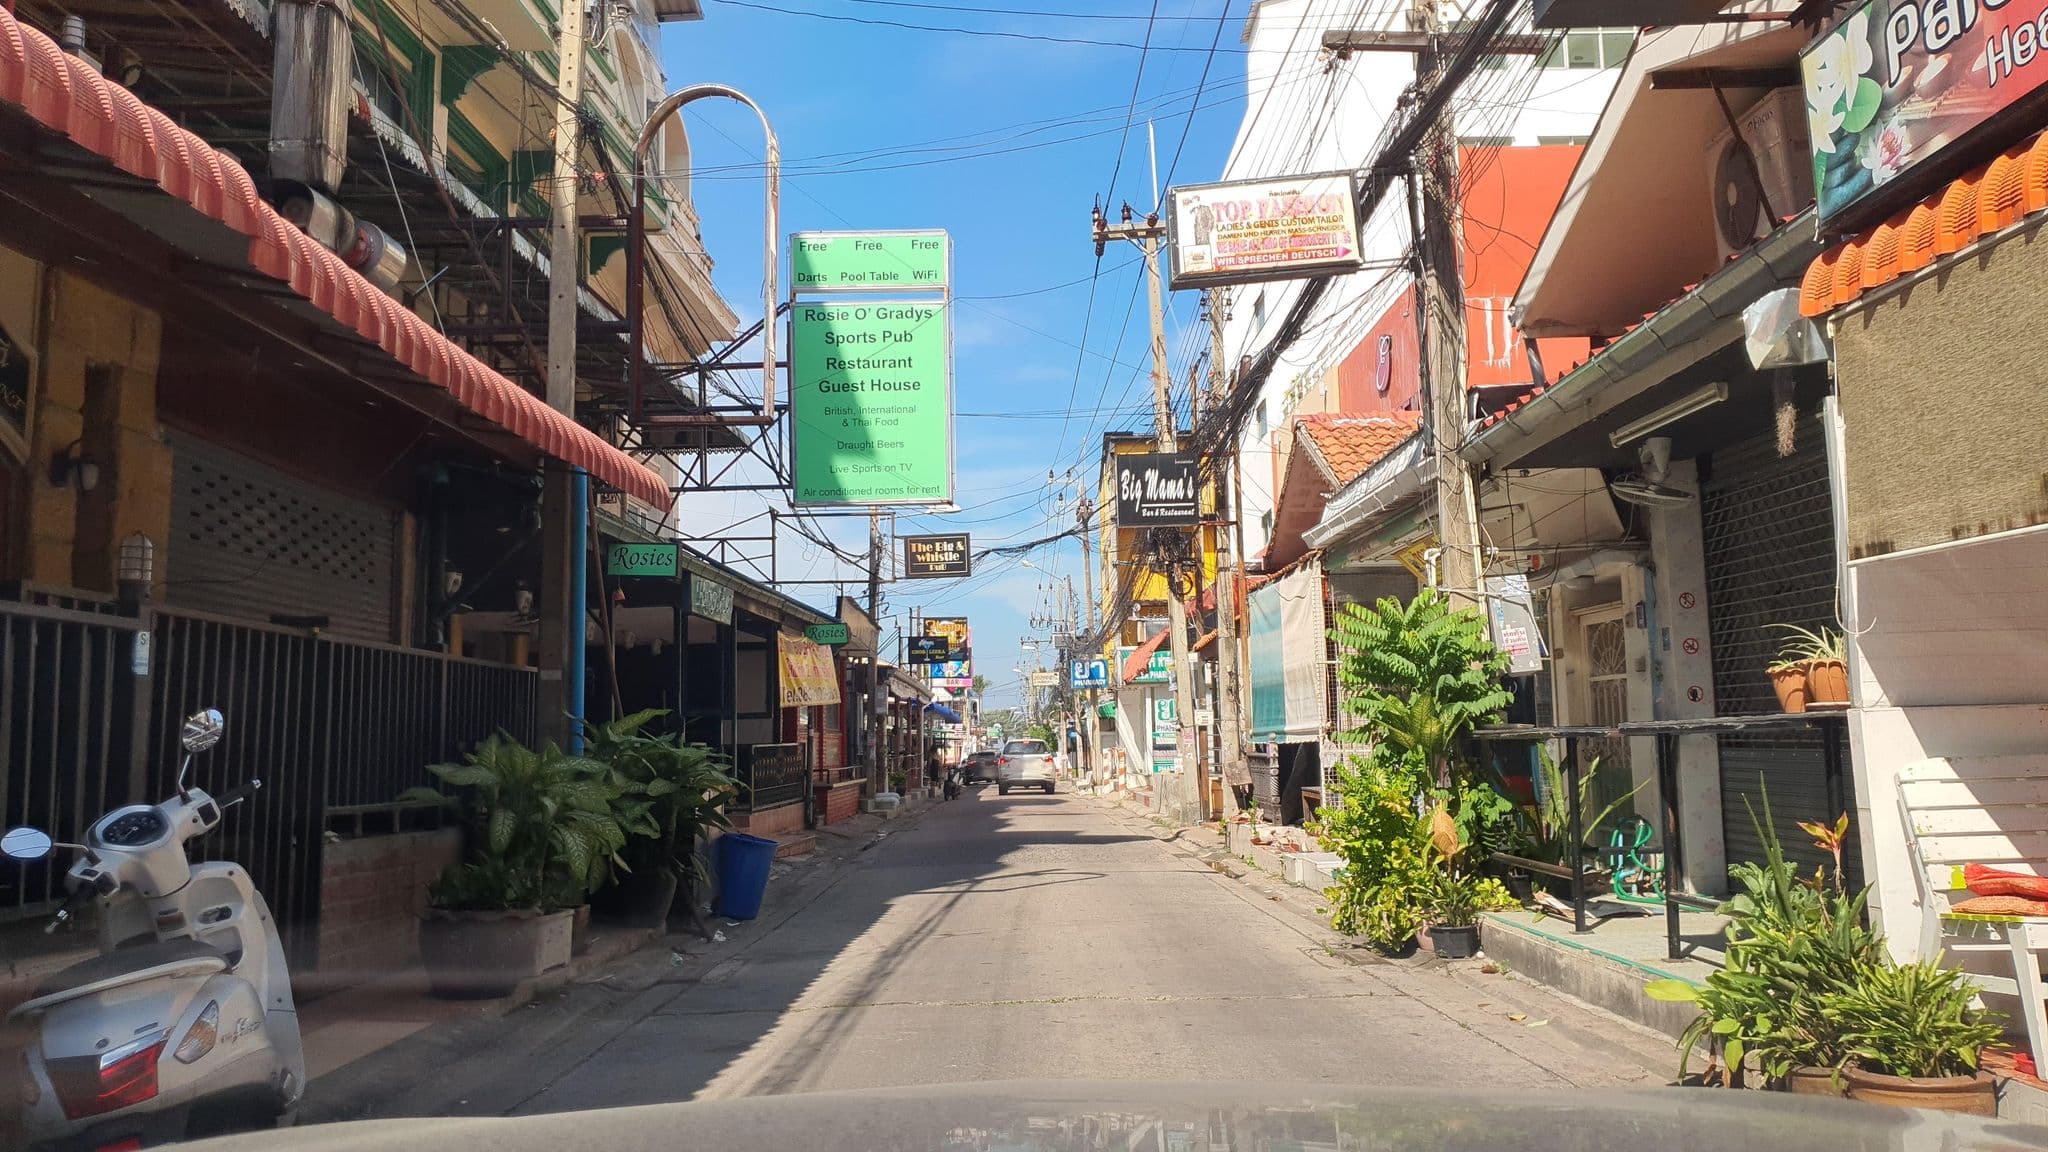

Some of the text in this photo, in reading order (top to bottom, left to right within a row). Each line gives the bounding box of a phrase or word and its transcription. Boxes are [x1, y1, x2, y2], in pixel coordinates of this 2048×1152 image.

[1211, 200, 1251, 223] TOP
[1216, 215, 1344, 232] LADIES & GENTS CUSTOM TAILOR
[1217, 232, 1242, 240] DAMEN
[799, 239, 939, 252] Free Free Free
[1216, 256, 1236, 266] WIR
[1237, 252, 1288, 265] SPRECHEN
[1291, 247, 1337, 259] DEUTSCH
[797, 270, 938, 282] Darts Pool Table WiFi
[805, 308, 849, 321] Rosie
[876, 307, 933, 322] Gradys
[824, 330, 913, 347] Sports Pub
[826, 356, 913, 370] Restaurant
[818, 378, 921, 393] Guest House
[824, 405, 917, 416] British, International
[842, 417, 899, 427] & Thai Food
[837, 440, 905, 450] Draught Beers
[830, 463, 913, 474] Live Sports on TV
[803, 485, 940, 497] Air conditioned rooms for rent
[1121, 467, 1195, 513] Big Mama's
[1142, 508, 1154, 517] Bar
[1160, 508, 1195, 516] Restaurant
[911, 542, 933, 552] The
[956, 541, 965, 551] &
[613, 546, 673, 570] Rosies
[808, 625, 845, 641] Rosies
